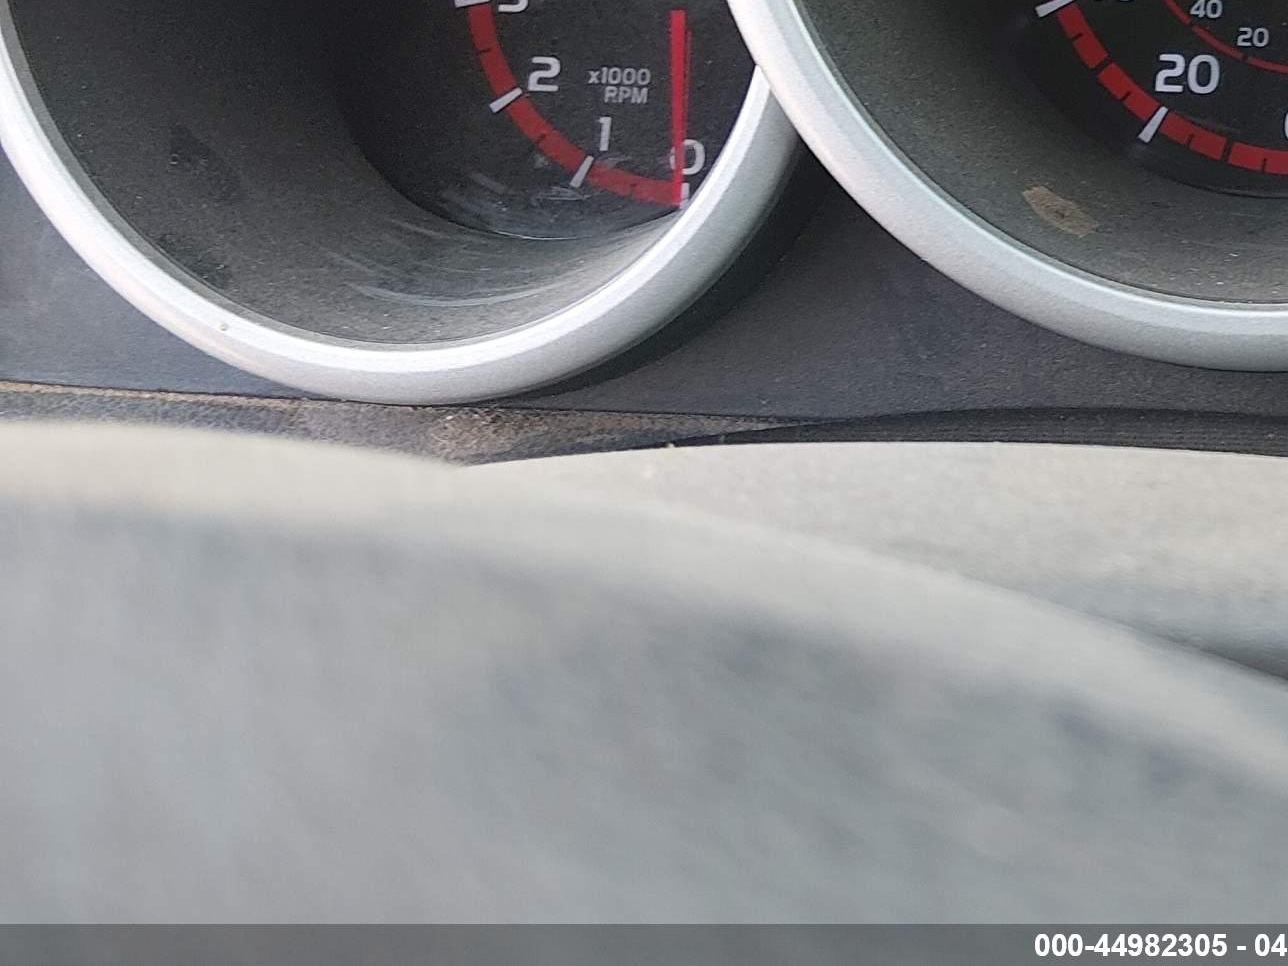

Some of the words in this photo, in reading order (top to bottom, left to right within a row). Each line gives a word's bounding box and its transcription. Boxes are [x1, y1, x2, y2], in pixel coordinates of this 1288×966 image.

[1190, 0, 1223, 18] 40
[1237, 27, 1269, 47] 20
[529, 56, 561, 92] 2
[588, 67, 651, 85] x1000
[1155, 54, 1220, 94] 20
[604, 86, 649, 103] RPM
[598, 116, 612, 152] 1
